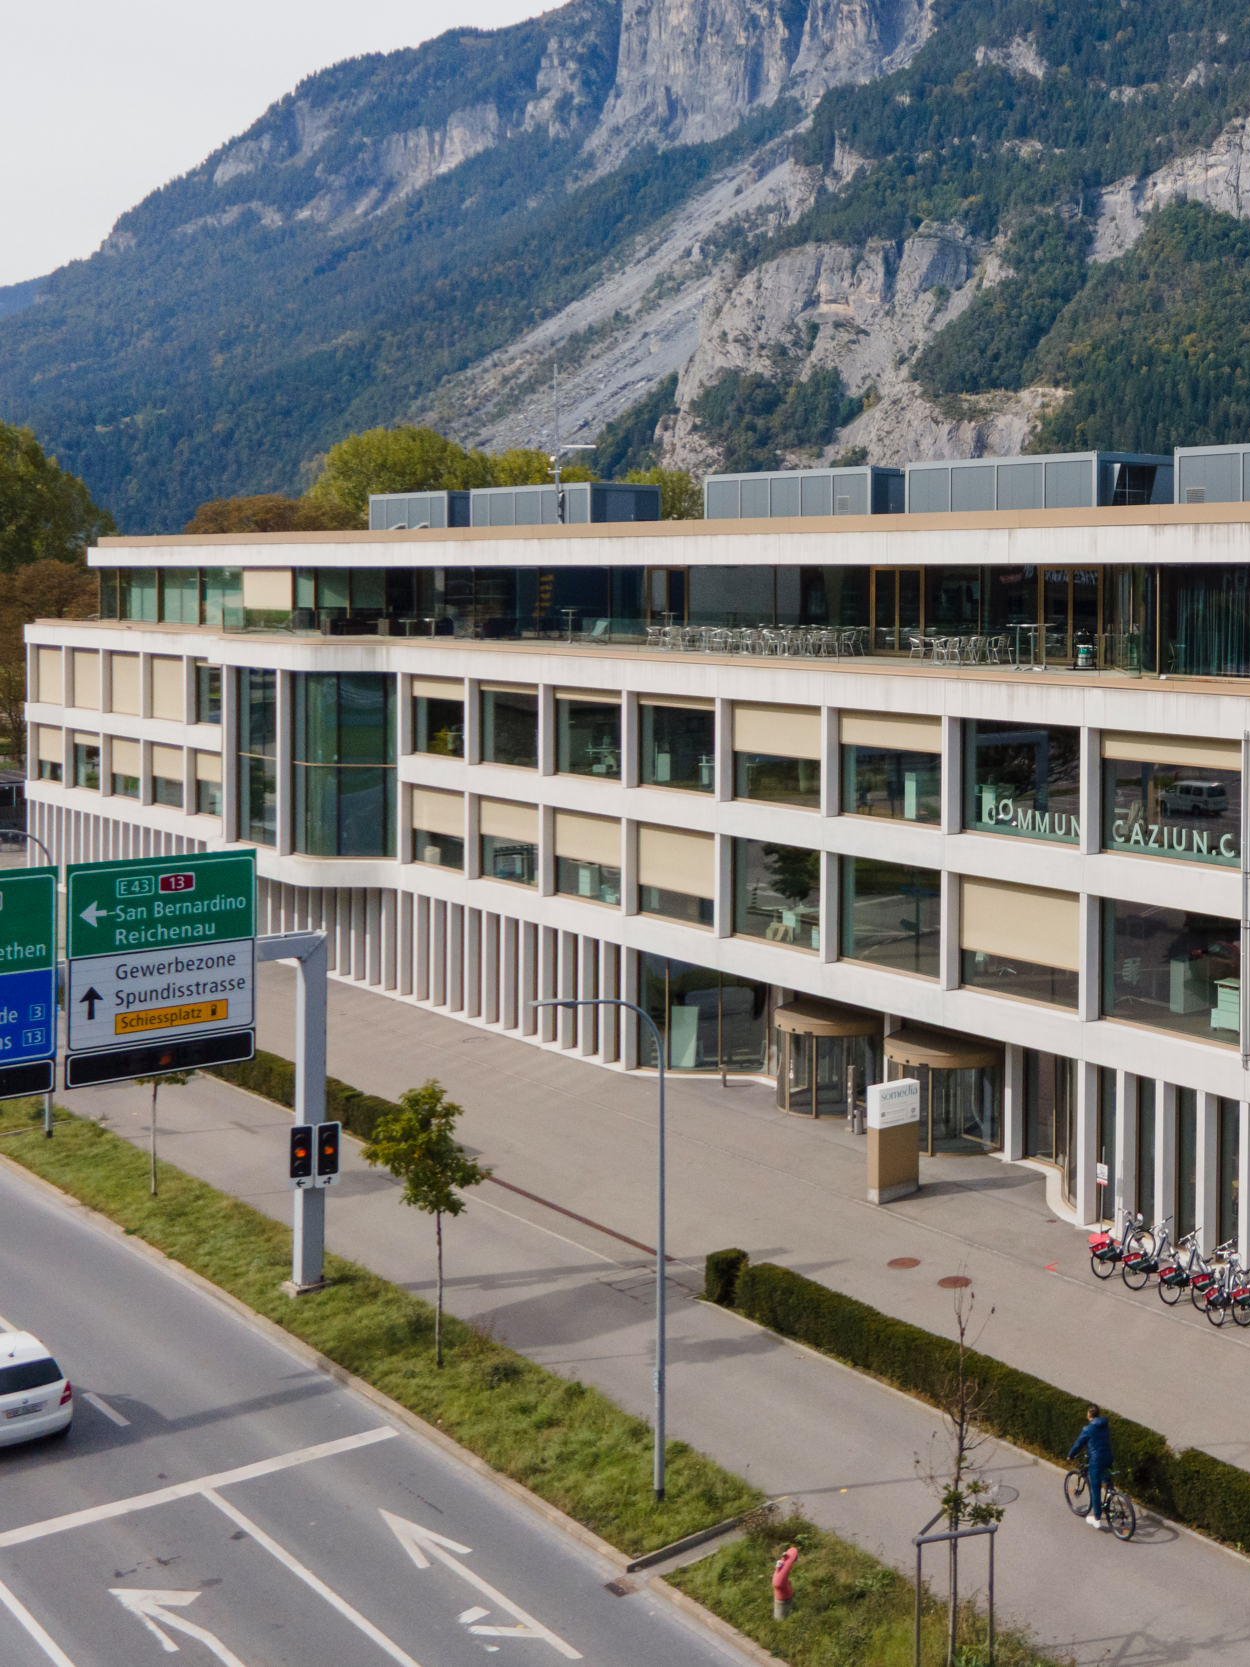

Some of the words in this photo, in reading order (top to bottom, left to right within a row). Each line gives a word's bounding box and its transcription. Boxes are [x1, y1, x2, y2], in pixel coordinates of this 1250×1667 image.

[120, 881, 128, 894] E
[131, 880, 149, 893] 43
[169, 876, 185, 890] 13
[116, 905, 147, 921] San
[154, 894, 246, 917] Bernardino
[115, 922, 215, 945] Reichenau
[115, 954, 236, 980] Gewerbezone
[115, 977, 246, 1009] Spundisstrasse
[34, 1006, 42, 1018] 3
[121, 1008, 202, 1029] Schiessplatz
[26, 1030, 42, 1044] 13
[881, 1084, 918, 1101] somedia
